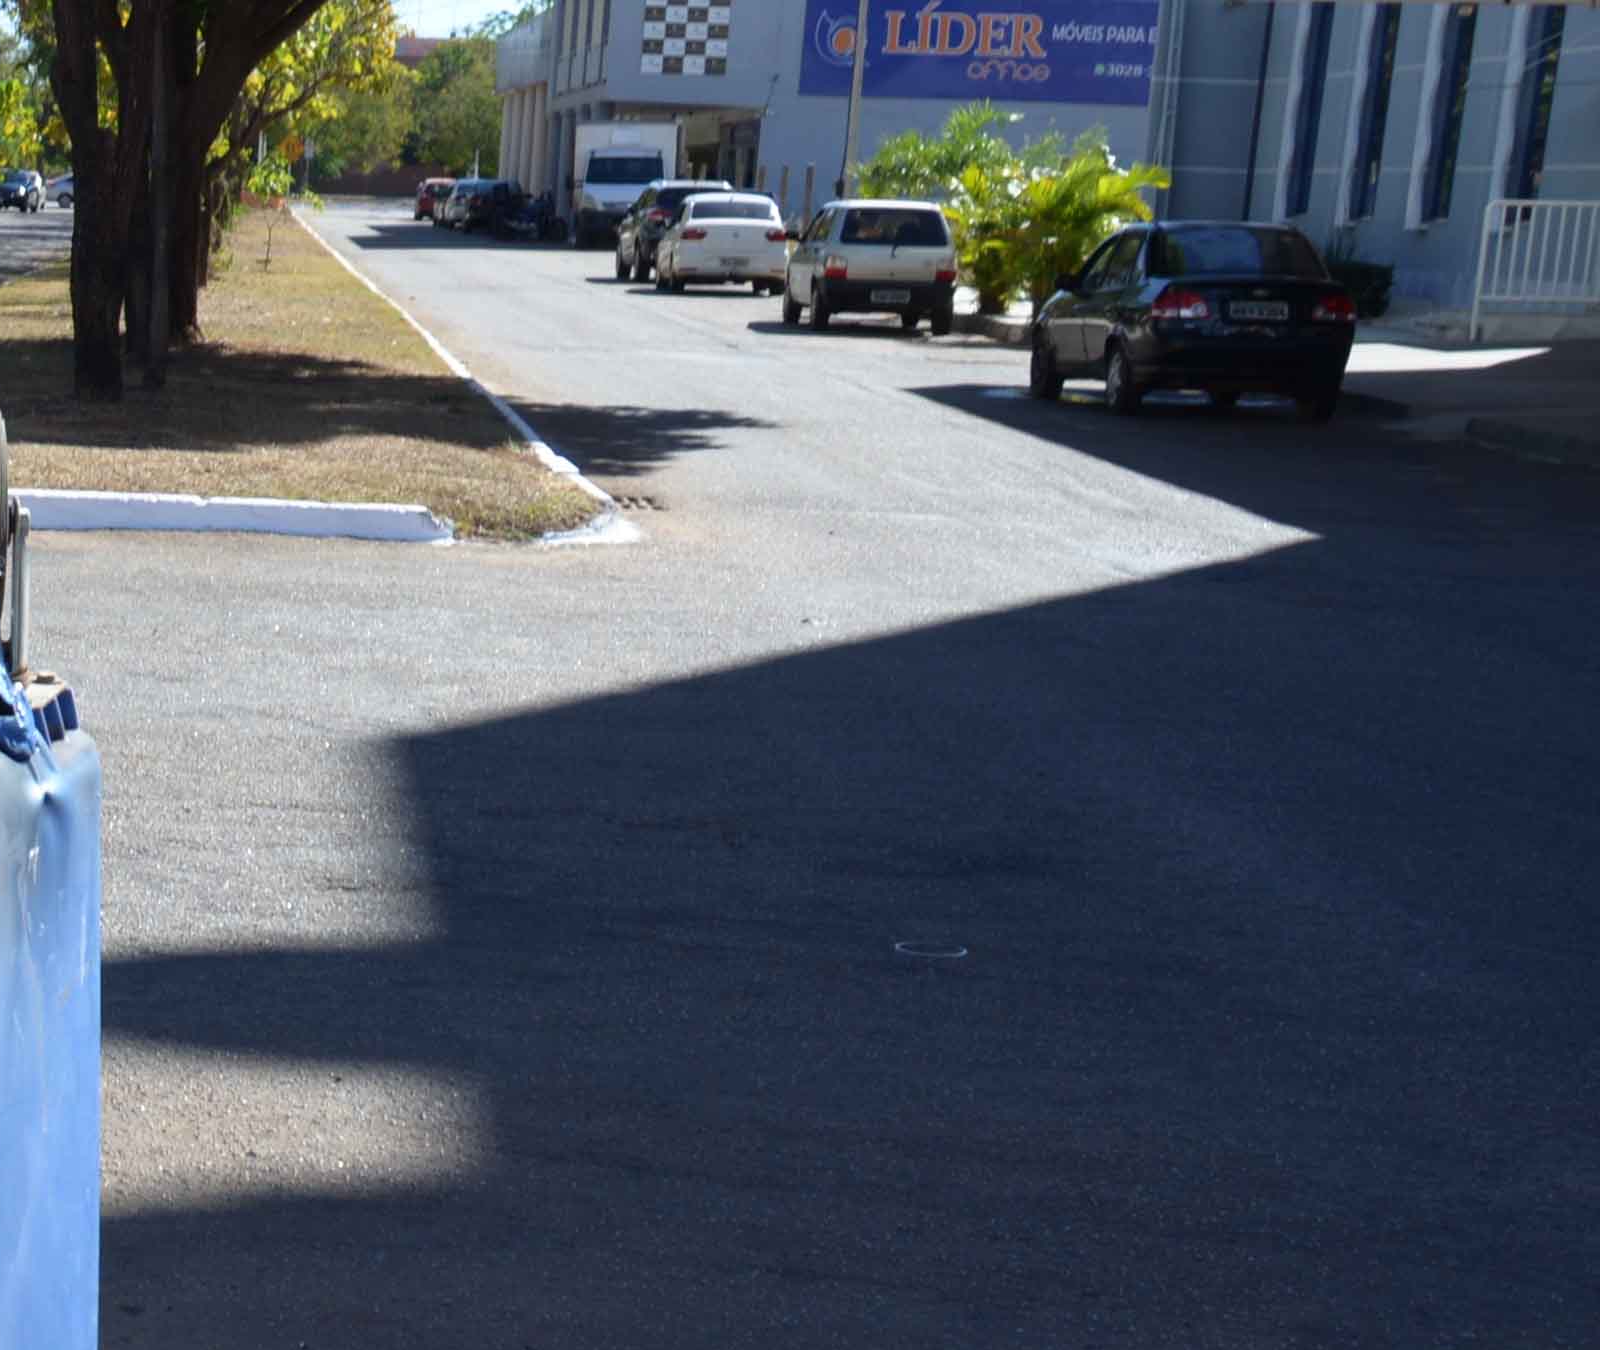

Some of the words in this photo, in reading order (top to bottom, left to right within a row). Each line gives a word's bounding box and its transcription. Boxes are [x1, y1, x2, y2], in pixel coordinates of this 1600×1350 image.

[881, 0, 1047, 58] LÍDER
[1052, 20, 1104, 43] MÓVEIS
[1106, 25, 1145, 44] PARA
